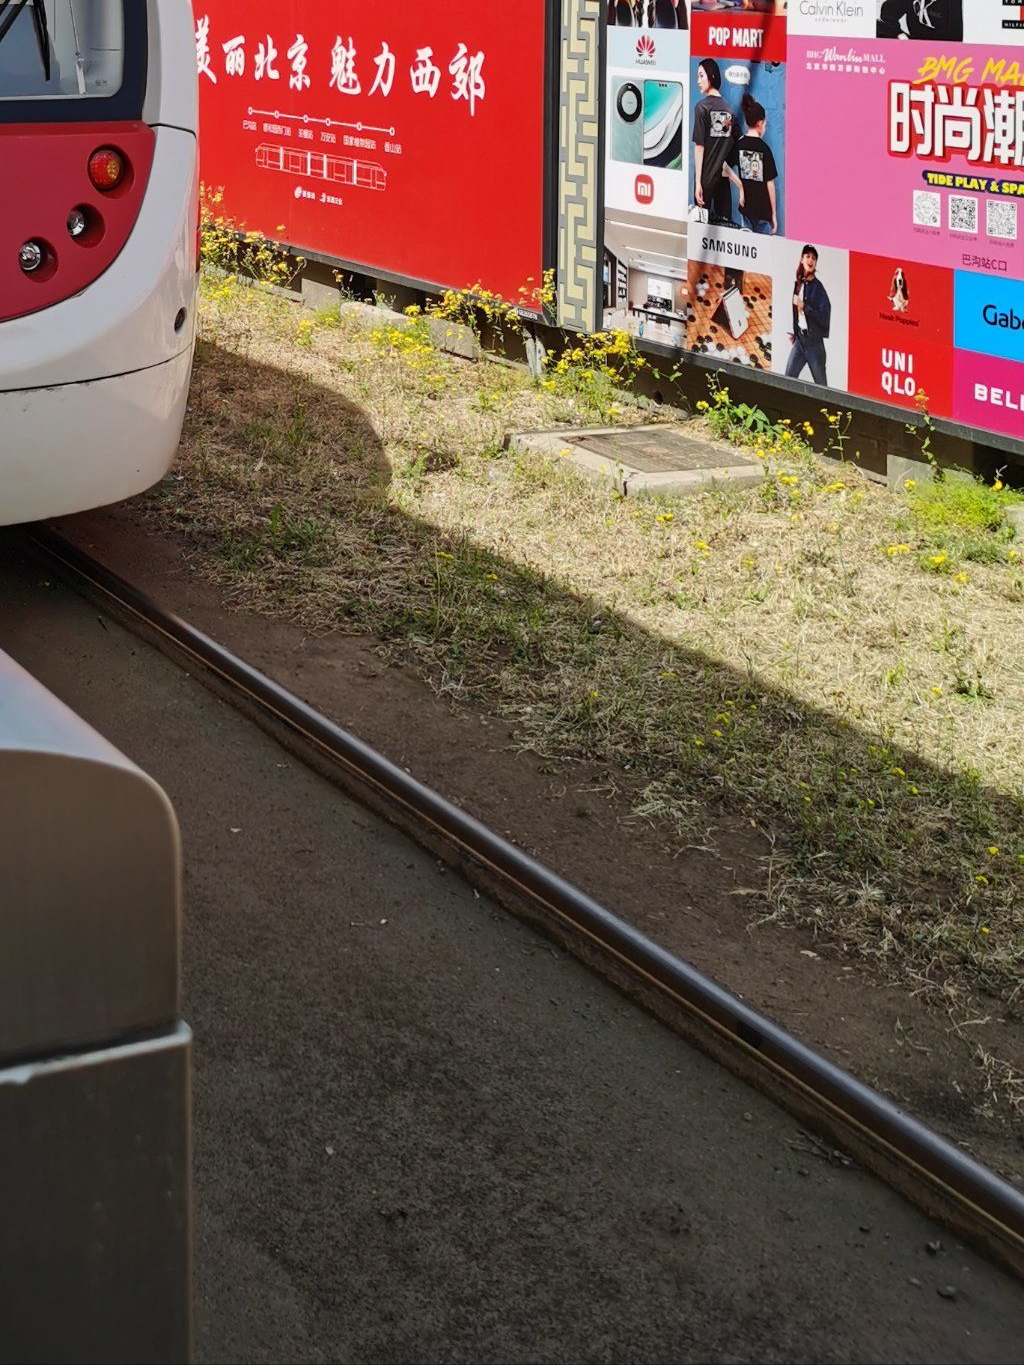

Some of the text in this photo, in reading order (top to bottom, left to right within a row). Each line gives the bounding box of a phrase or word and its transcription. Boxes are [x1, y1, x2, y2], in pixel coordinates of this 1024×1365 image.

[799, 0, 864, 17] Calvin Klein
[708, 25, 764, 48] POP MART
[195, 14, 486, 117] 美丽北京 魅力西郊
[912, 54, 975, 85] BMG
[927, 172, 954, 187] TIDE
[955, 176, 988, 191] PLAY
[990, 180, 1000, 193] &
[702, 237, 757, 259] SAMSUNG
[962, 254, 1007, 271] 巴沟站C口
[881, 347, 913, 374] UNI
[881, 371, 916, 397] QLO
